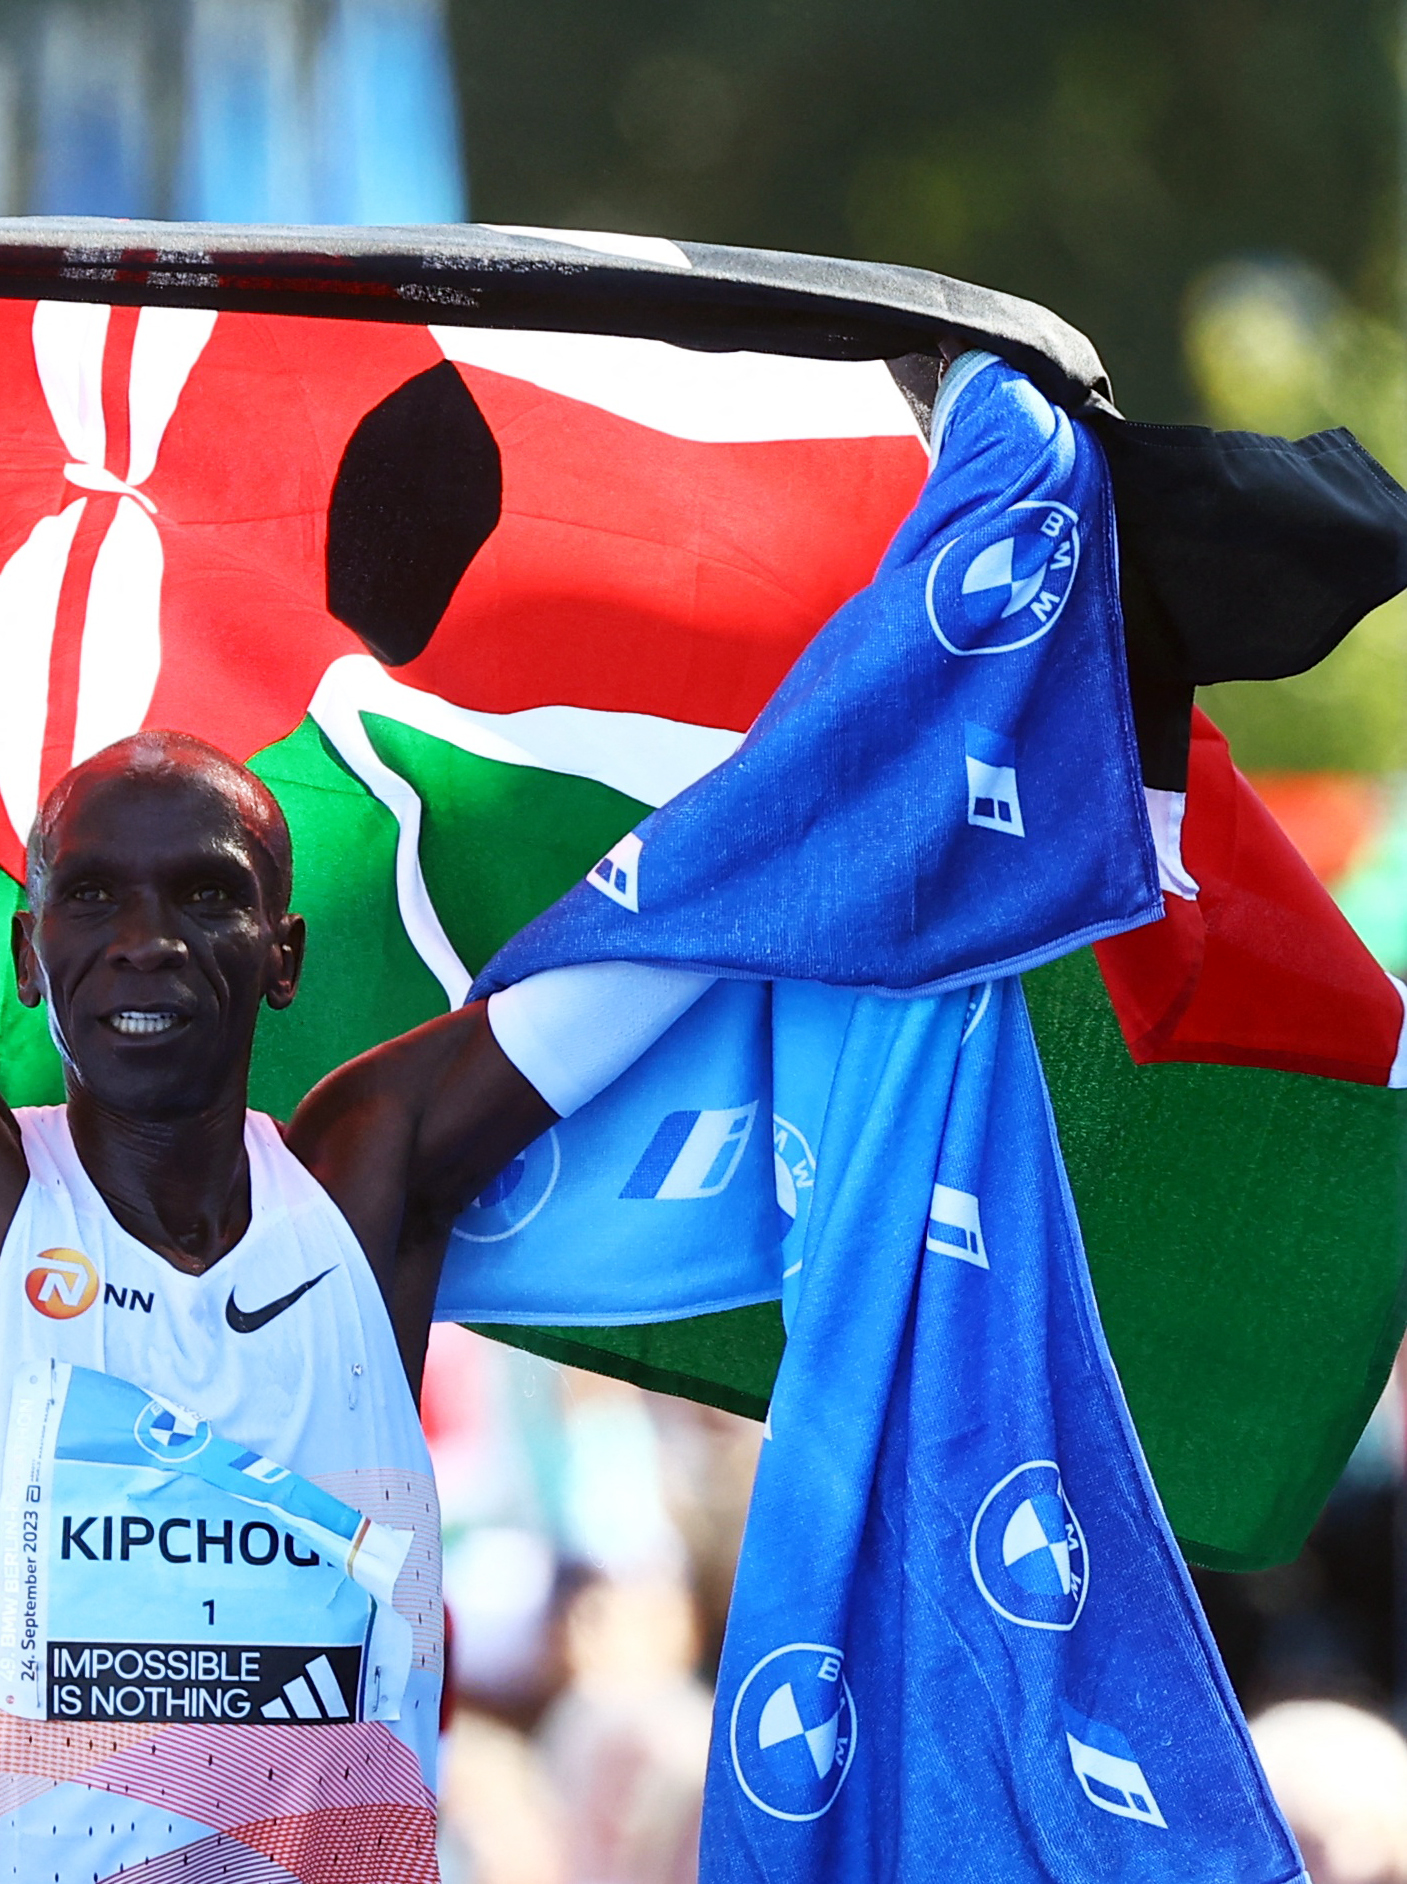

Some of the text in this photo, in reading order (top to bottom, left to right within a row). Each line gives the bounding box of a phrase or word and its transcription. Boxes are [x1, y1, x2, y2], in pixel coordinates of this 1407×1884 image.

[1030, 510, 1072, 623] BMW
[103, 1281, 155, 1314] NN
[60, 1515, 338, 1568] KIPCHOG
[20, 1509, 39, 1682] 24. September 2023
[201, 1598, 216, 1626] 1
[0, 1597, 19, 1649] BMW
[53, 1648, 261, 1682] IMPOSSIBLE
[52, 1684, 252, 1718] IS NOTHING
